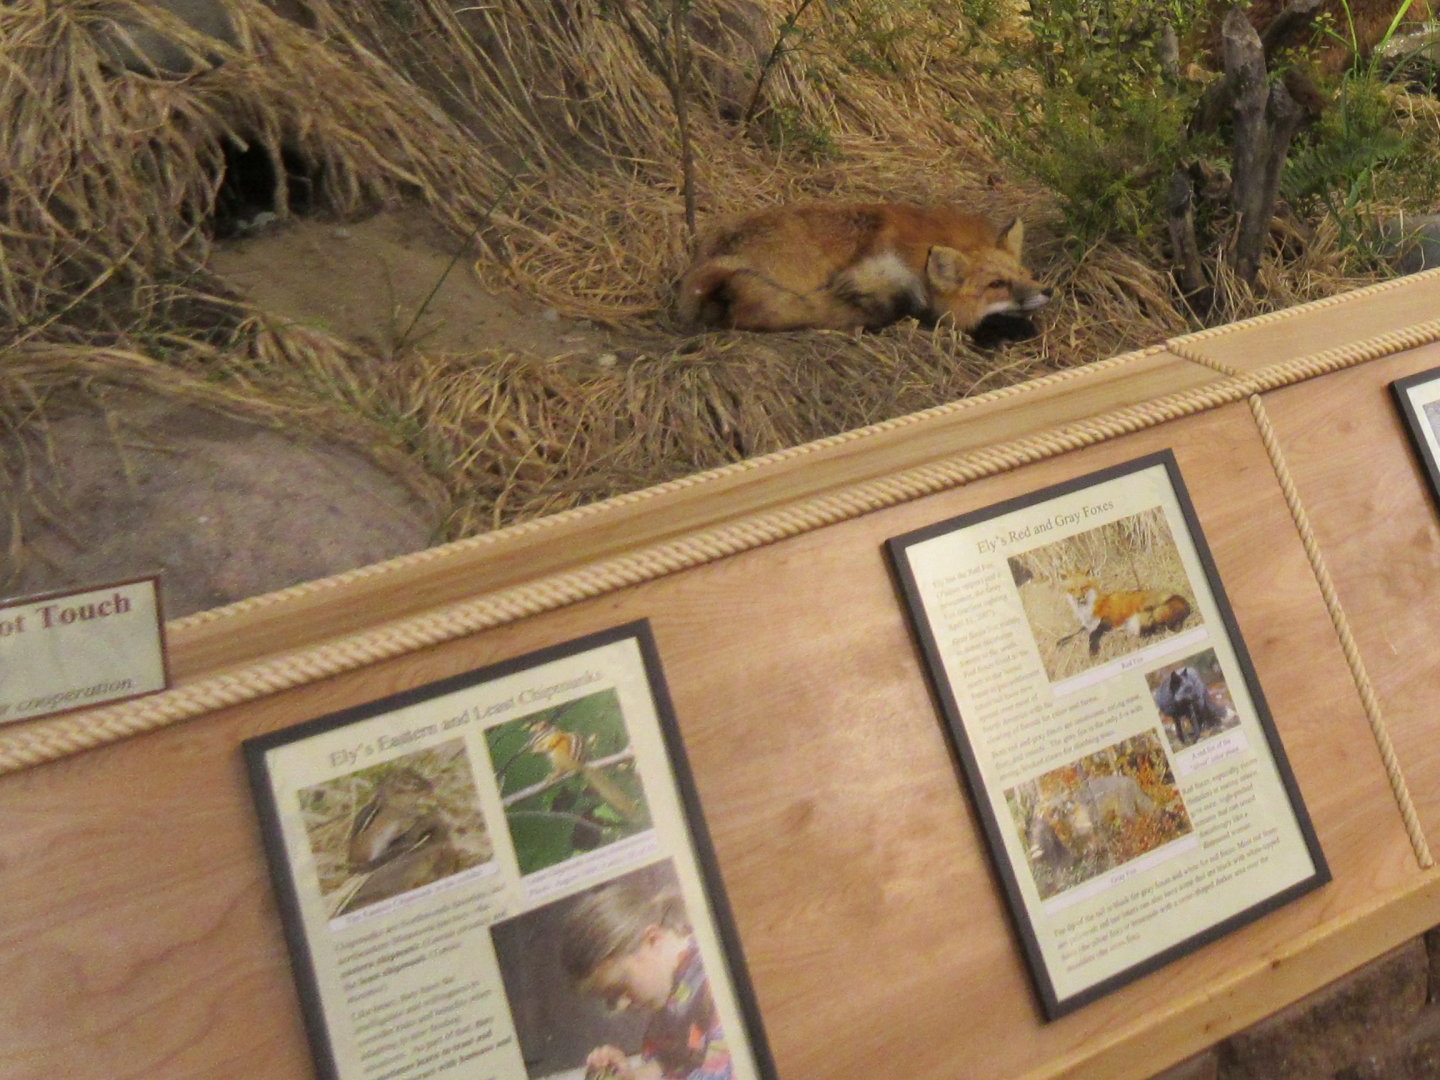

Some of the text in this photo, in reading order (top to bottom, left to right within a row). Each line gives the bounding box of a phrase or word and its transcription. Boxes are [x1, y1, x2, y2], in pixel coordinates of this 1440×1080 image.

[976, 500, 1114, 553] Ely's Red and Gray Foxes
[35, 593, 132, 628] Touch
[329, 743, 373, 767] Ely's
[378, 723, 435, 749] Eastern
[441, 711, 470, 729] and
[474, 697, 514, 717] Least
